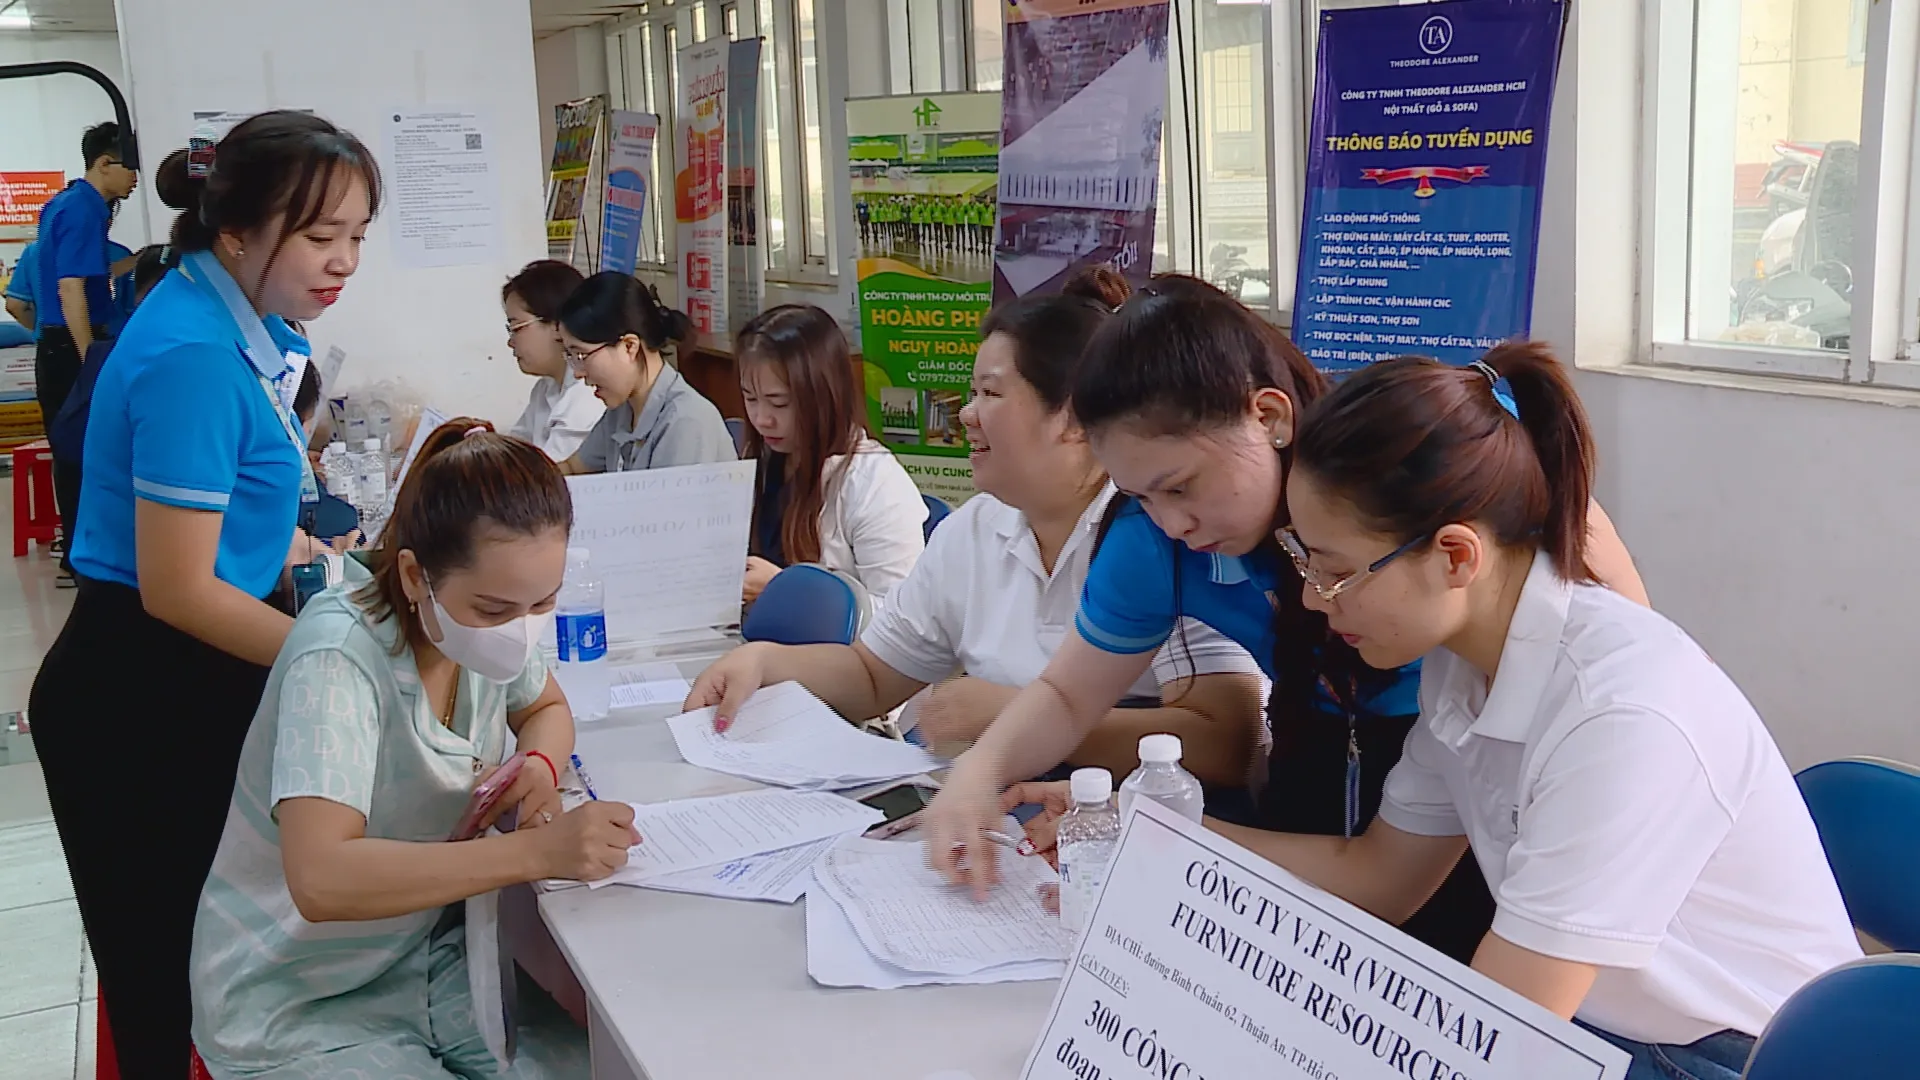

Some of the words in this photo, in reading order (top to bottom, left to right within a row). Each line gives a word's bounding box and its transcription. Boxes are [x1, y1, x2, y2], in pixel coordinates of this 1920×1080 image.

[1425, 26, 1446, 45] TA
[1390, 58, 1430, 68] THEODORE
[1432, 55, 1479, 65] ALEXANDER
[1341, 90, 1365, 100] CÔNG
[1366, 90, 1377, 99] TY
[1379, 88, 1403, 99] TNHH
[1405, 86, 1451, 97] THEODORE
[1452, 82, 1504, 95] ALEXANDER
[1505, 81, 1526, 91] HCM
[1383, 104, 1400, 116] NỘI
[1401, 102, 1425, 114] THẤT
[1443, 104, 1450, 113] &
[1452, 102, 1478, 112] SOFA)
[1326, 132, 1384, 152] THÔNG
[1388, 129, 1422, 150] BÁO
[1425, 127, 1480, 149] TUYỂN
[1484, 129, 1534, 150] DỤNG
[1323, 214, 1342, 223] LAO
[1343, 212, 1368, 224] ĐỘNG
[1390, 212, 1420, 223] THÔNG
[1322, 232, 1342, 242] THỢ
[1393, 231, 1412, 241] MÁY
[1320, 245, 1356, 255] KHOAN,
[1378, 245, 1399, 256] BÀO,
[1400, 245, 1411, 255] ÉP
[1442, 245, 1454, 256] ÉP
[1320, 256, 1337, 267] LẮP
[1360, 258, 1378, 268] CHÀ
[1318, 276, 1339, 287] THỢ
[1339, 274, 1356, 286] LẮP
[1357, 278, 1388, 287] KHUNG
[864, 290, 889, 301] CÔNG
[889, 292, 900, 301] TY
[902, 292, 925, 301] TNHH
[927, 292, 955, 301] TM-DV
[956, 291, 974, 301] MÔI
[1316, 293, 1334, 305] LẬP
[1336, 294, 1362, 304] TRÌNH
[1385, 296, 1404, 308] VẬN
[1405, 296, 1432, 307] HÀNH
[1433, 298, 1452, 308] CNC
[871, 305, 945, 327] HOÀNG
[951, 308, 985, 328] PH
[1328, 313, 1358, 324] THUẬT
[1381, 315, 1401, 326] THỢ
[1401, 317, 1420, 326] SƠN
[1313, 331, 1333, 342] THỢ
[1334, 332, 1352, 343] BỌC
[1377, 335, 1396, 345] THỢ
[1421, 337, 1440, 347] THỢ
[1332, 348, 1346, 359] TRÌ
[918, 360, 945, 371] GIÁM
[948, 361, 972, 372] ĐỐC
[924, 466, 939, 478] VỤ
[1170, 901, 1303, 1002] FURNITURE
[1186, 860, 1251, 916] CÔNG
[1254, 896, 1290, 937] TY
[1292, 916, 1352, 977] V.F.R
[1354, 956, 1501, 1064] (VIETNAM
[1105, 925, 1121, 944] ĐỊA
[1144, 952, 1171, 980] đường
[1193, 983, 1224, 1013] Chuẩn
[1240, 1013, 1270, 1044] Thuận
[1270, 1037, 1287, 1059] An,
[1085, 1000, 1121, 1042] 300
